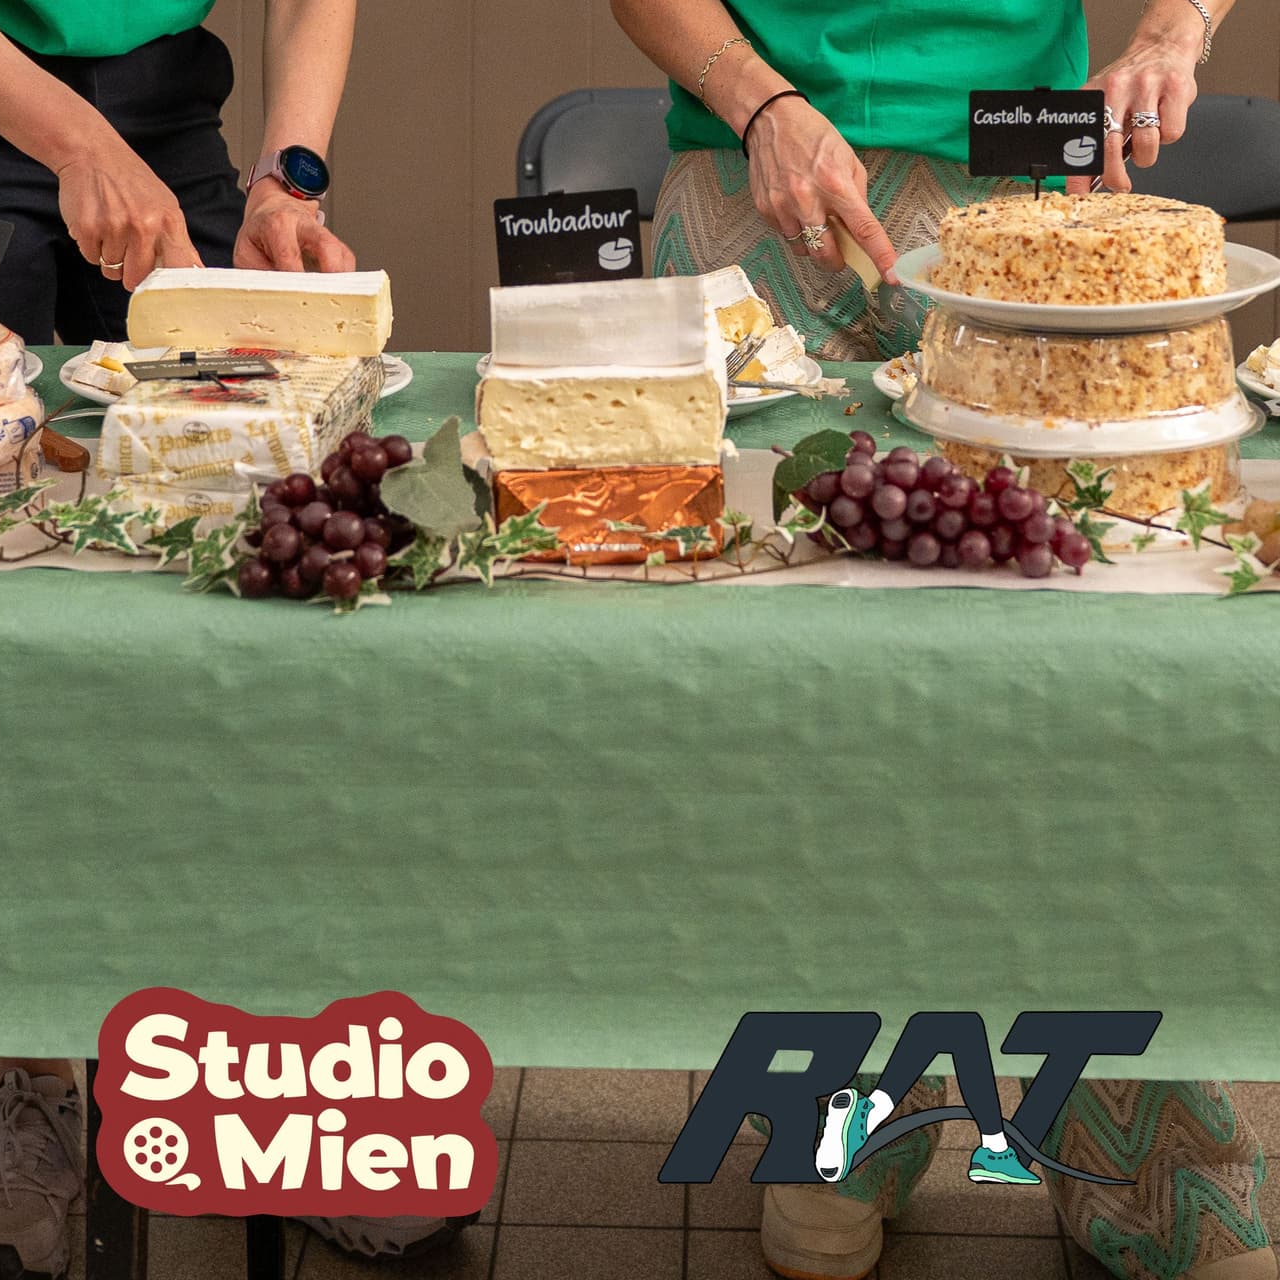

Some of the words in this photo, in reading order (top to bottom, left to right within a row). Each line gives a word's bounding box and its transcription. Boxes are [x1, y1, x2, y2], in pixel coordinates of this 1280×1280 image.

[973, 105, 1033, 125] Castello
[1036, 107, 1097, 125] Ananas
[499, 204, 632, 237] Troubadour
